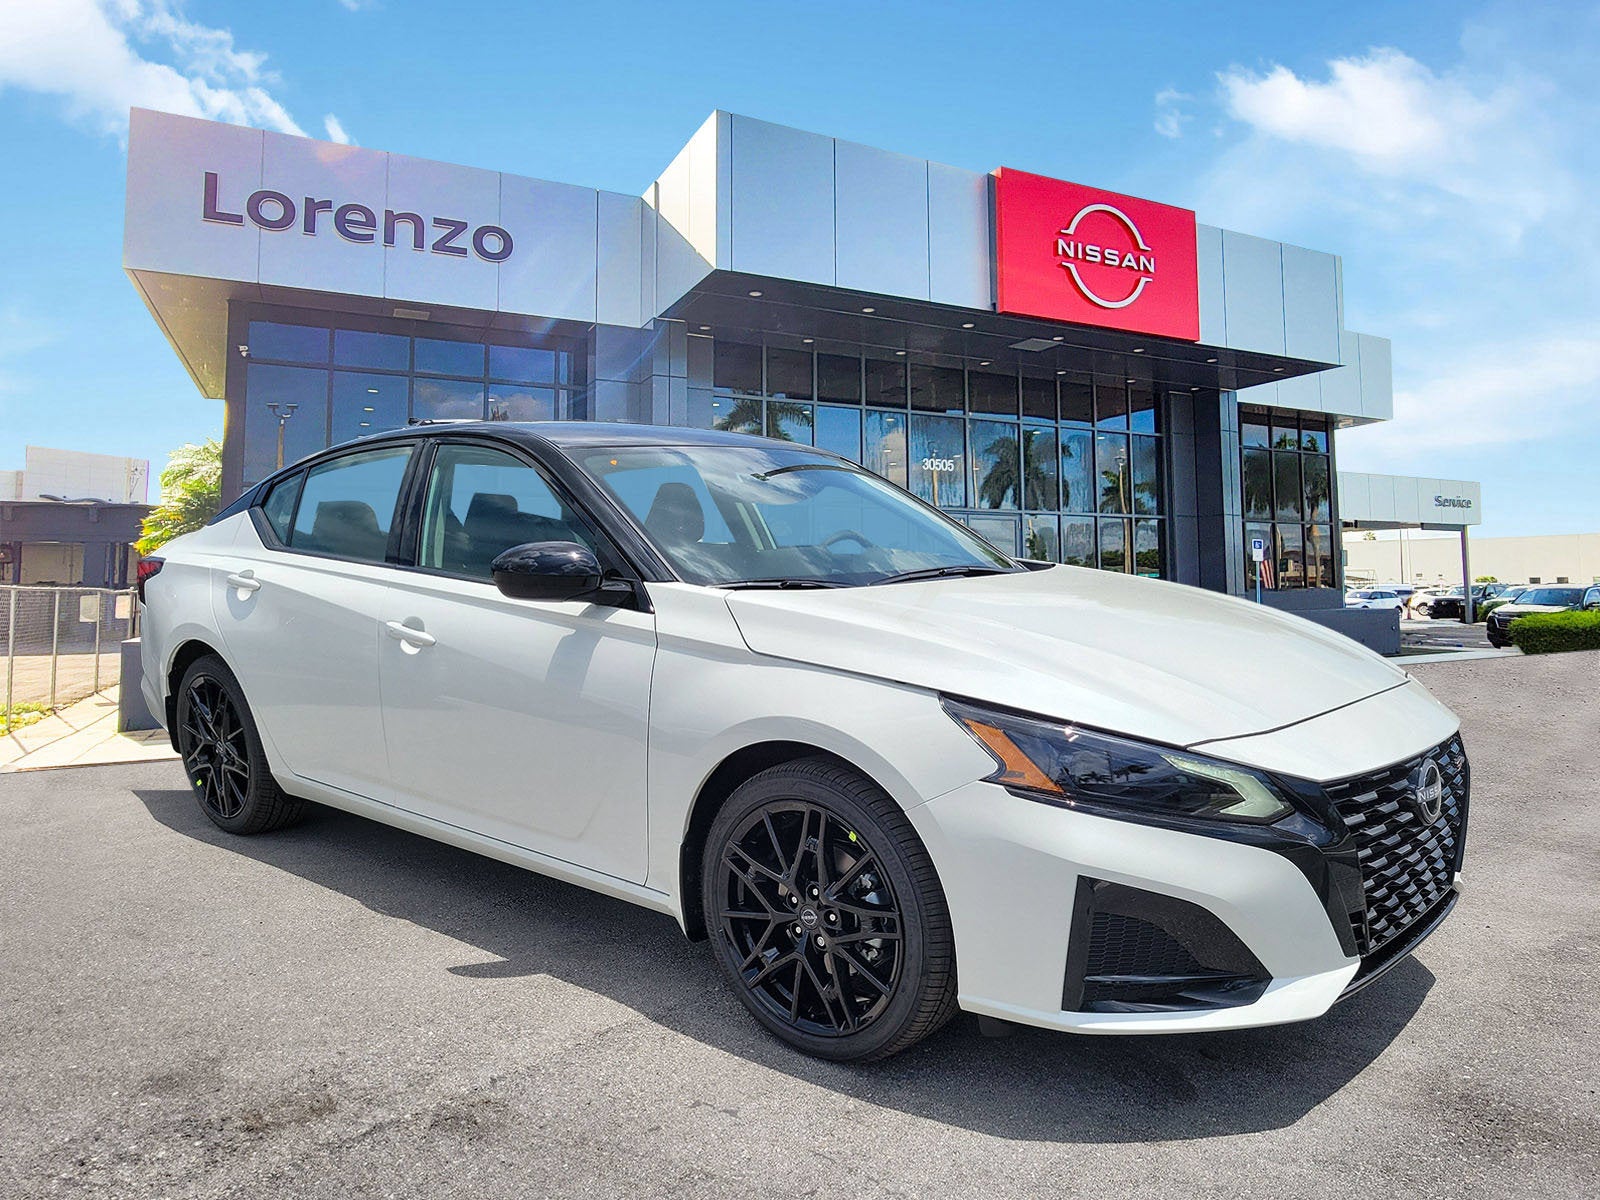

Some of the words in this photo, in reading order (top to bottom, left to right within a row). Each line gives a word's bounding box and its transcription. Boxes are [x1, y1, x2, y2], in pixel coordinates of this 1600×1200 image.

[202, 171, 514, 262] Lorenzo
[1057, 238, 1155, 273] NISSAN
[922, 458, 954, 471] 30505
[1434, 495, 1472, 509] Service
